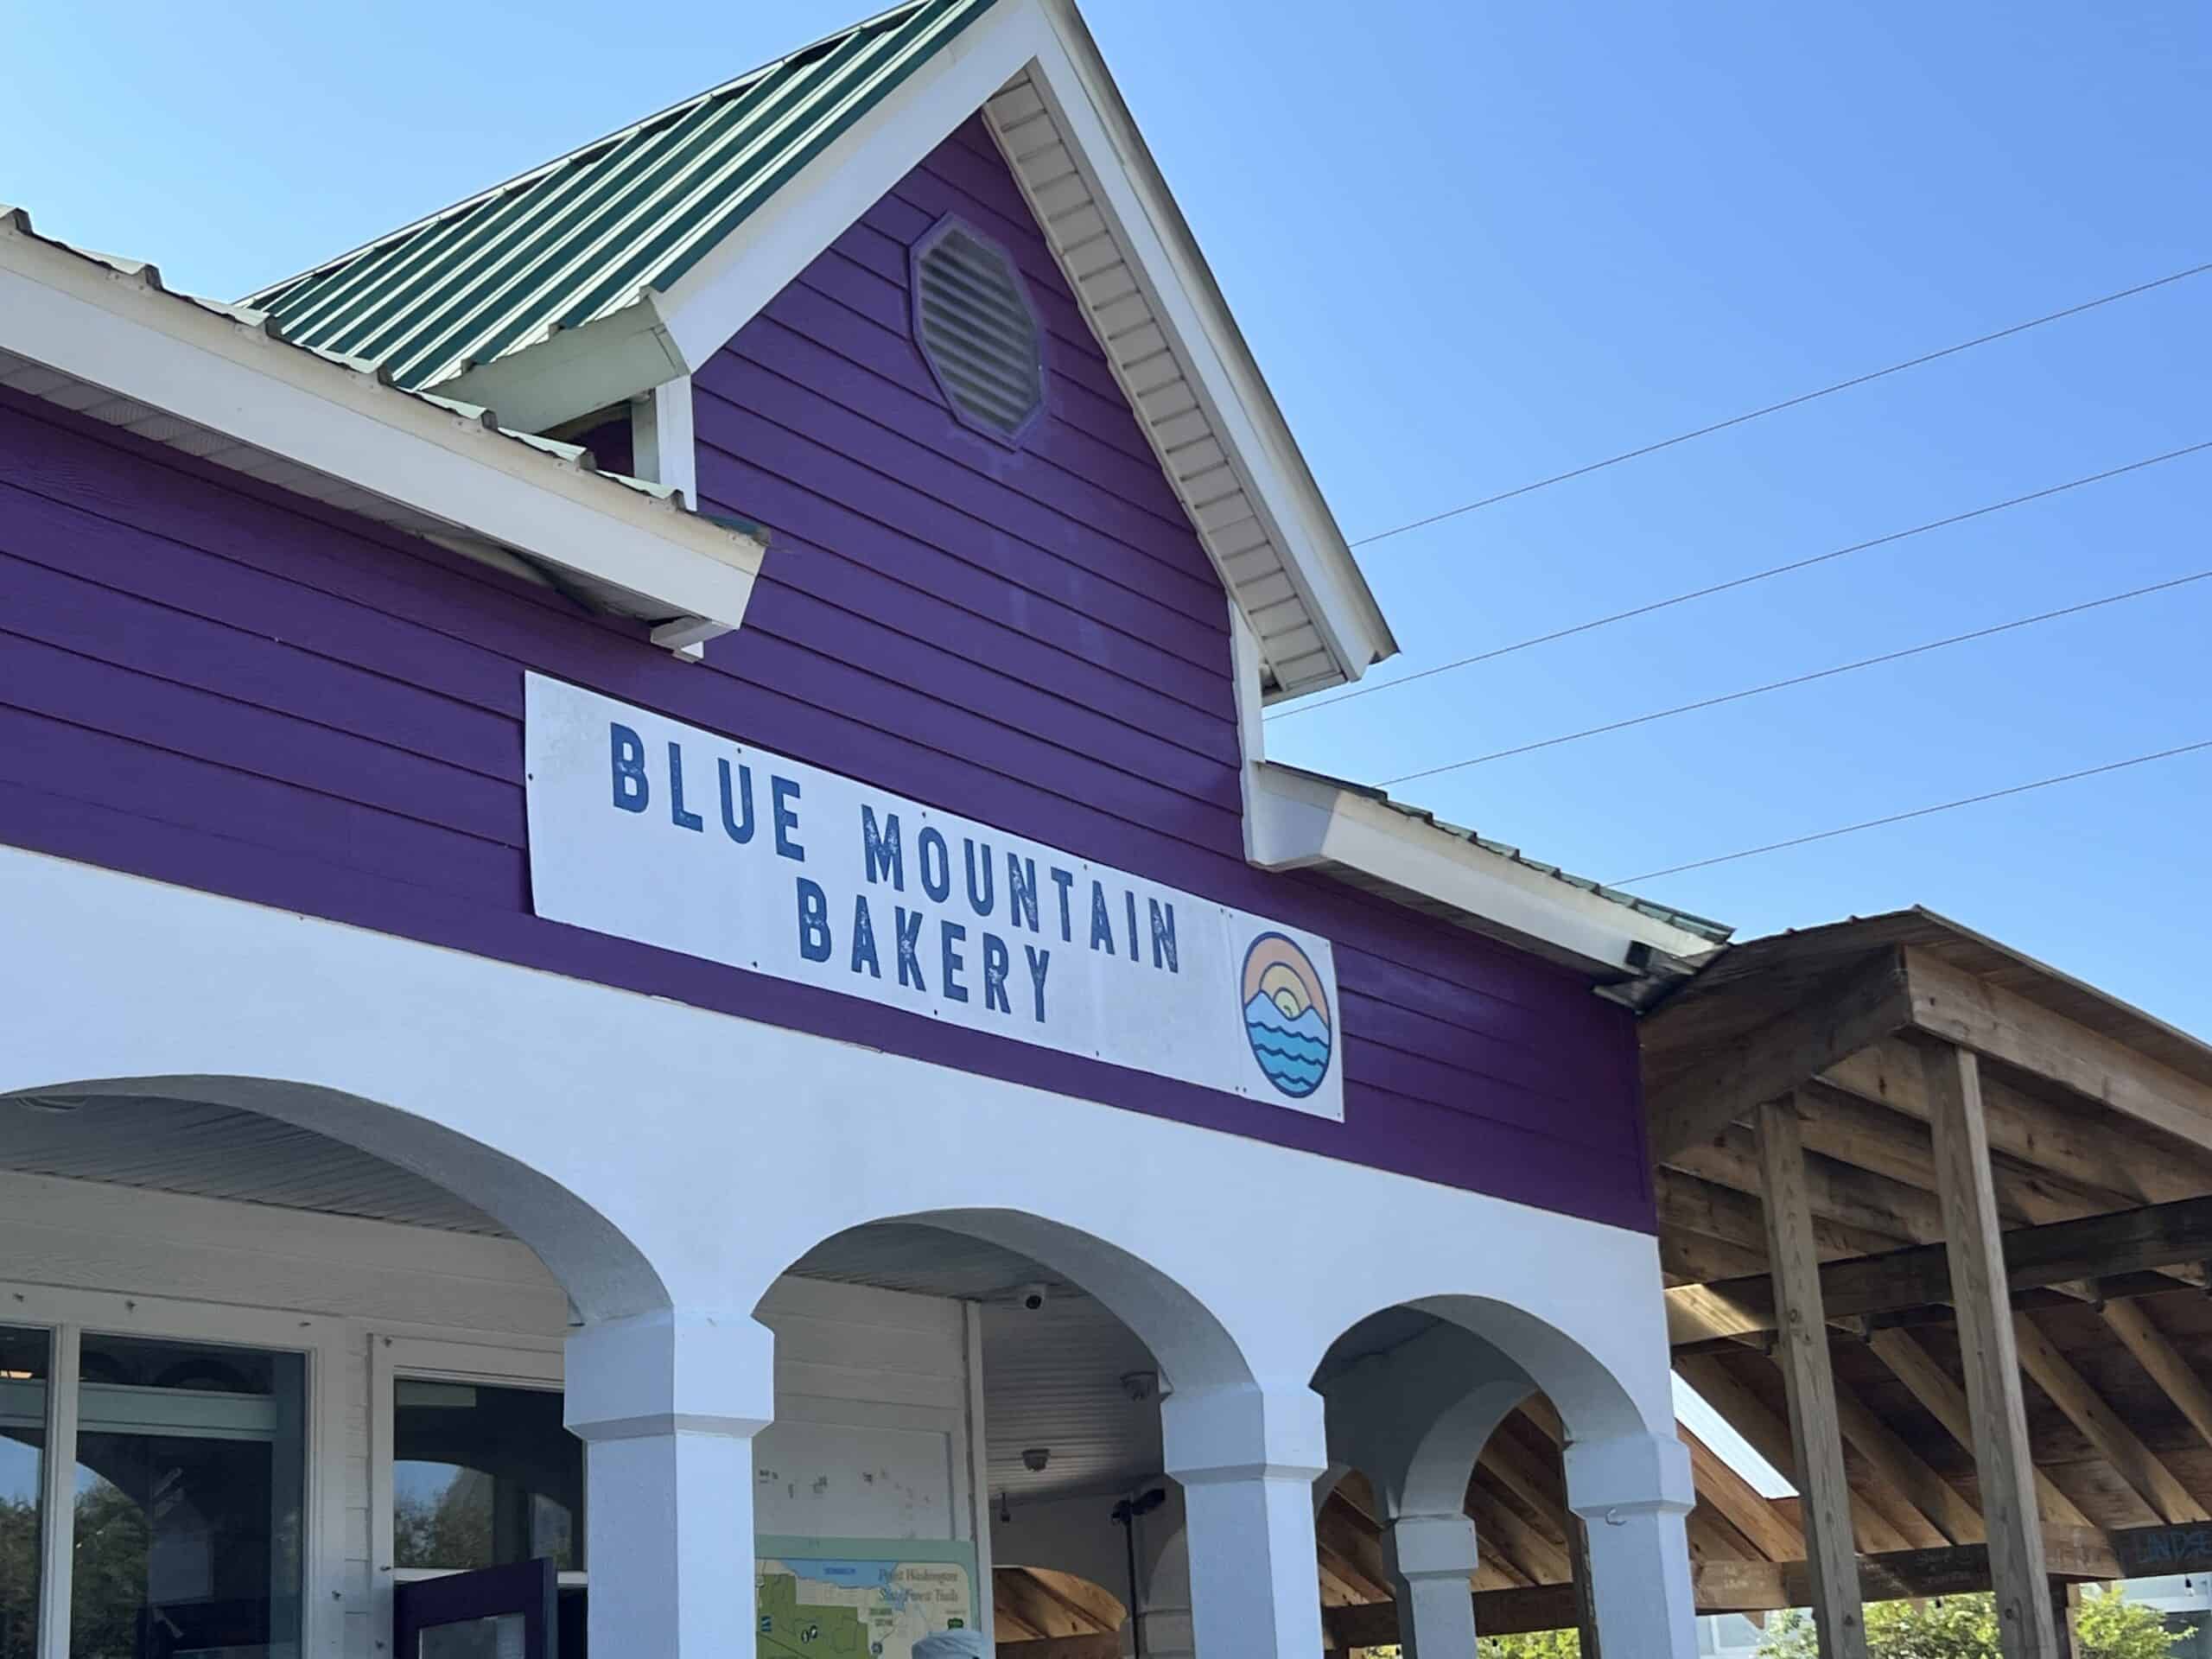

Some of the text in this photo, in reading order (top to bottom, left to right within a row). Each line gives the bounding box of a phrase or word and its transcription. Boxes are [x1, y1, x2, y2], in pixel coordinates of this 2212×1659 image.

[609, 721, 1180, 975] BLUE MOUNTAIN
[795, 876, 1052, 1024] BAKERY
